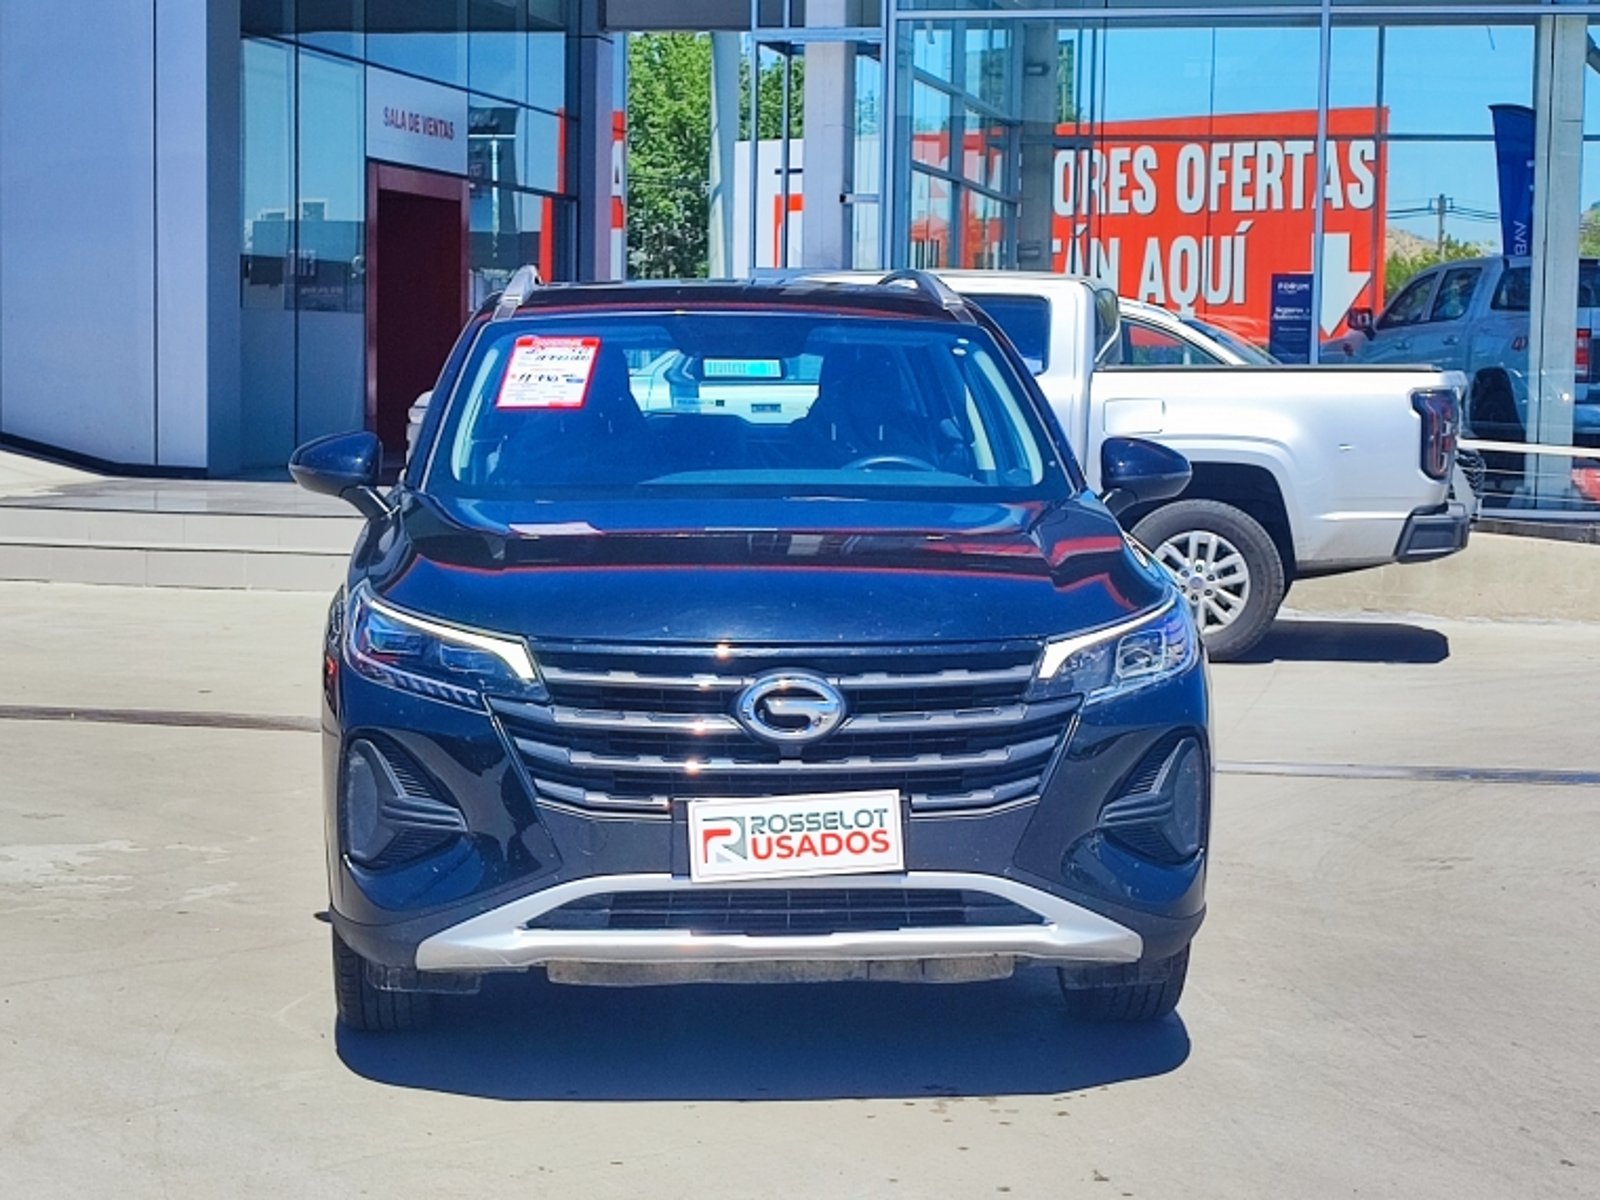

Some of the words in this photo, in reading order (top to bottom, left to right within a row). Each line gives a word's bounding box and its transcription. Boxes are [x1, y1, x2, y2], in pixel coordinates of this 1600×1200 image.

[383, 105, 406, 131] SALA
[408, 111, 420, 134] DE
[421, 115, 455, 141] VENTAS
[1053, 145, 1159, 216] ORES
[1176, 140, 1376, 214] OFERTAS
[1138, 220, 1254, 320] AQUÍ
[750, 808, 889, 835] ROSSELOT
[751, 829, 891, 860] USADOS
